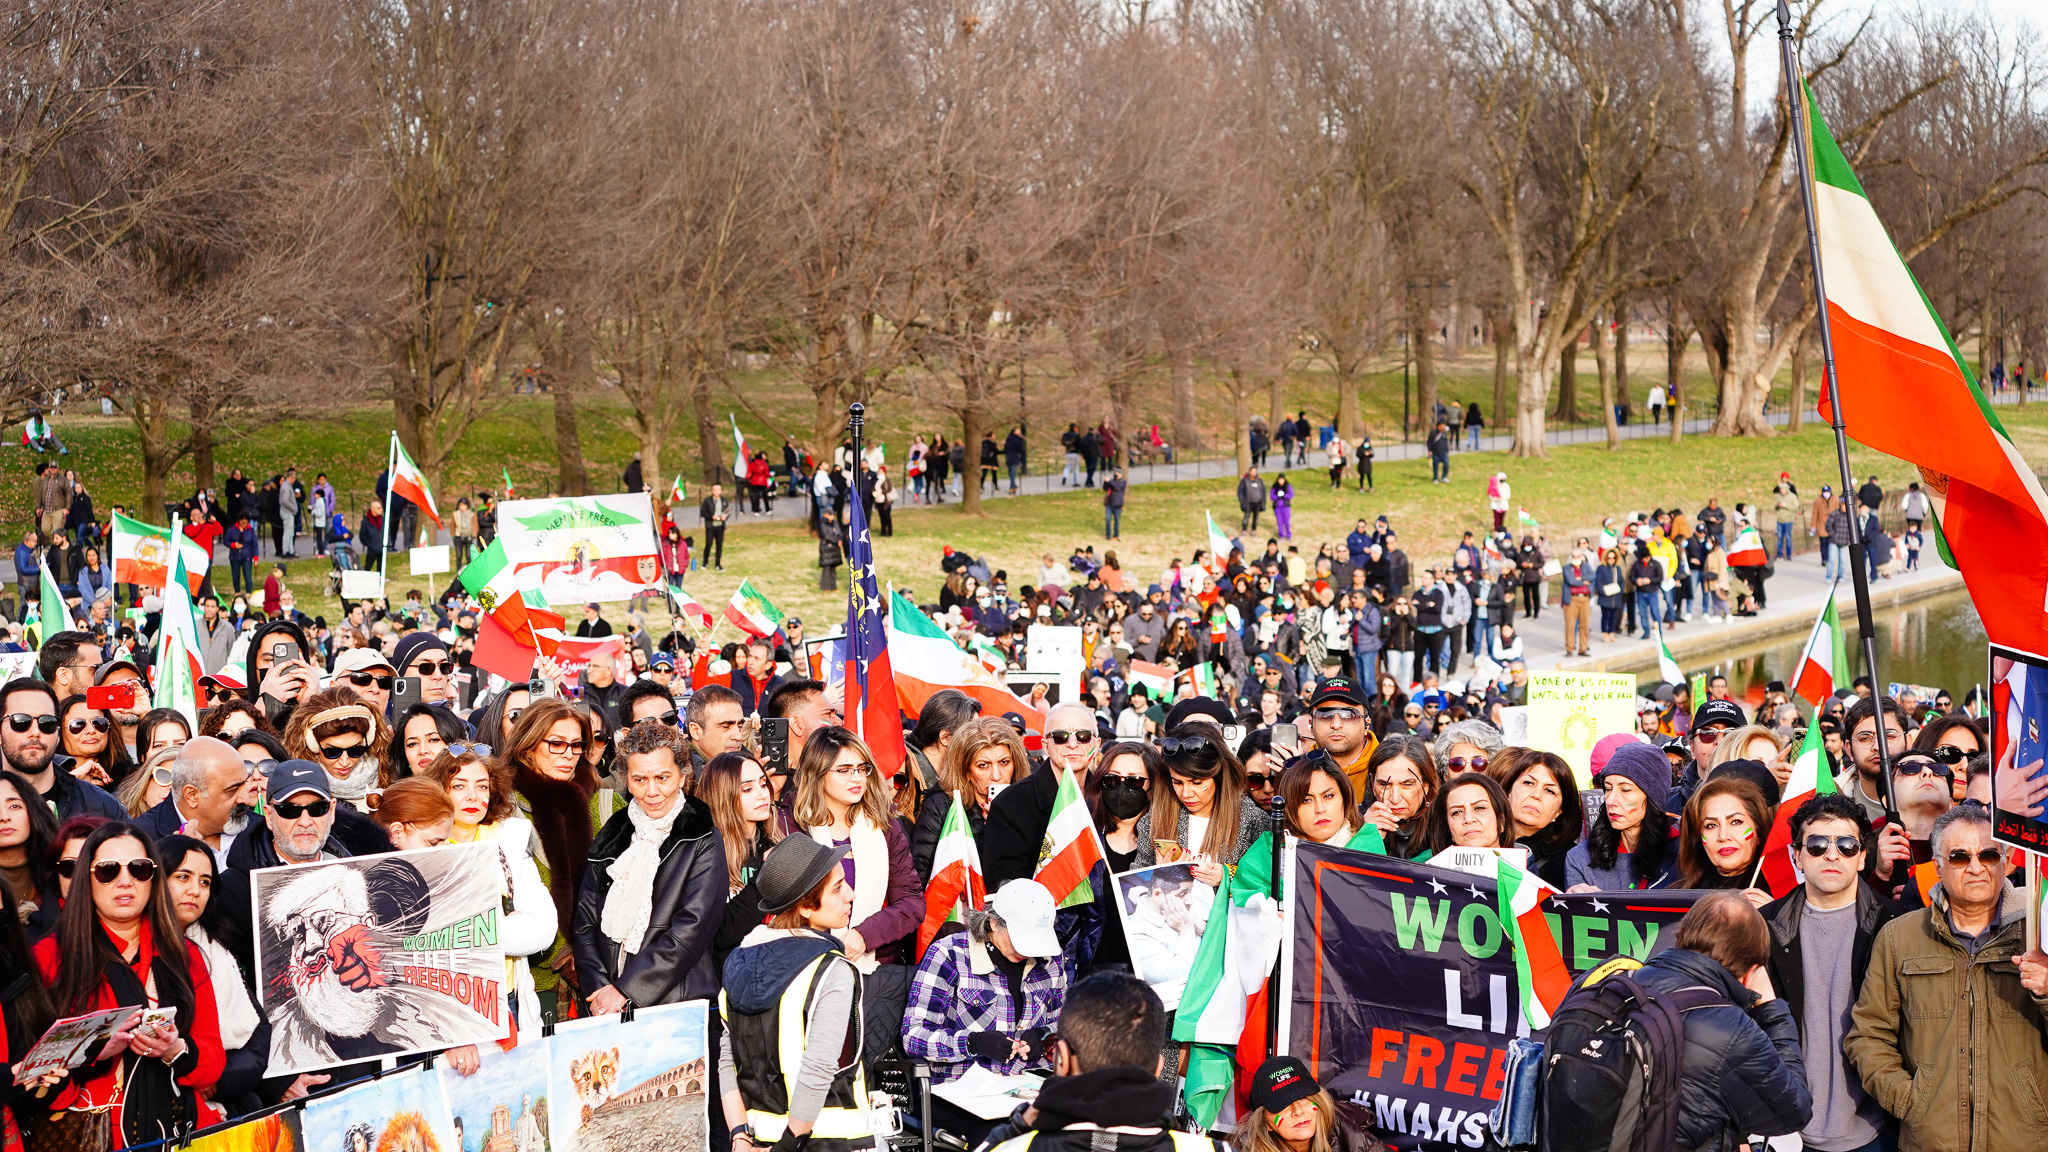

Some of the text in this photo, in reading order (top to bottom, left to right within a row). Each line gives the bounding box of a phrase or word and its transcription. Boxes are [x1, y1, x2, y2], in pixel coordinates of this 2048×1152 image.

[534, 515, 566, 547] WOMEN
[589, 511, 629, 542] FREEDOM
[1534, 677, 1560, 686] NONE
[1532, 691, 1560, 700] UNTIL
[1564, 691, 1577, 700] ALL
[1998, 819, 2018, 837] اتحاد
[2020, 824, 2037, 843] فقط
[1455, 853, 1485, 866] UNITY
[402, 907, 498, 951] WOMEN
[413, 948, 469, 975] LIFE
[1602, 962, 1621, 973] Nikon
[404, 966, 499, 1026] FREEDOM
[1444, 968, 1531, 1038] LI
[1581, 1047, 1602, 1058] deuter
[1269, 1066, 1294, 1080] WOMEN
[1368, 1027, 1507, 1101] FREE
[1272, 1076, 1300, 1092] FREEDOM
[1276, 1073, 1291, 1082] LIFE
[1350, 1090, 1490, 1148] #MAHS
